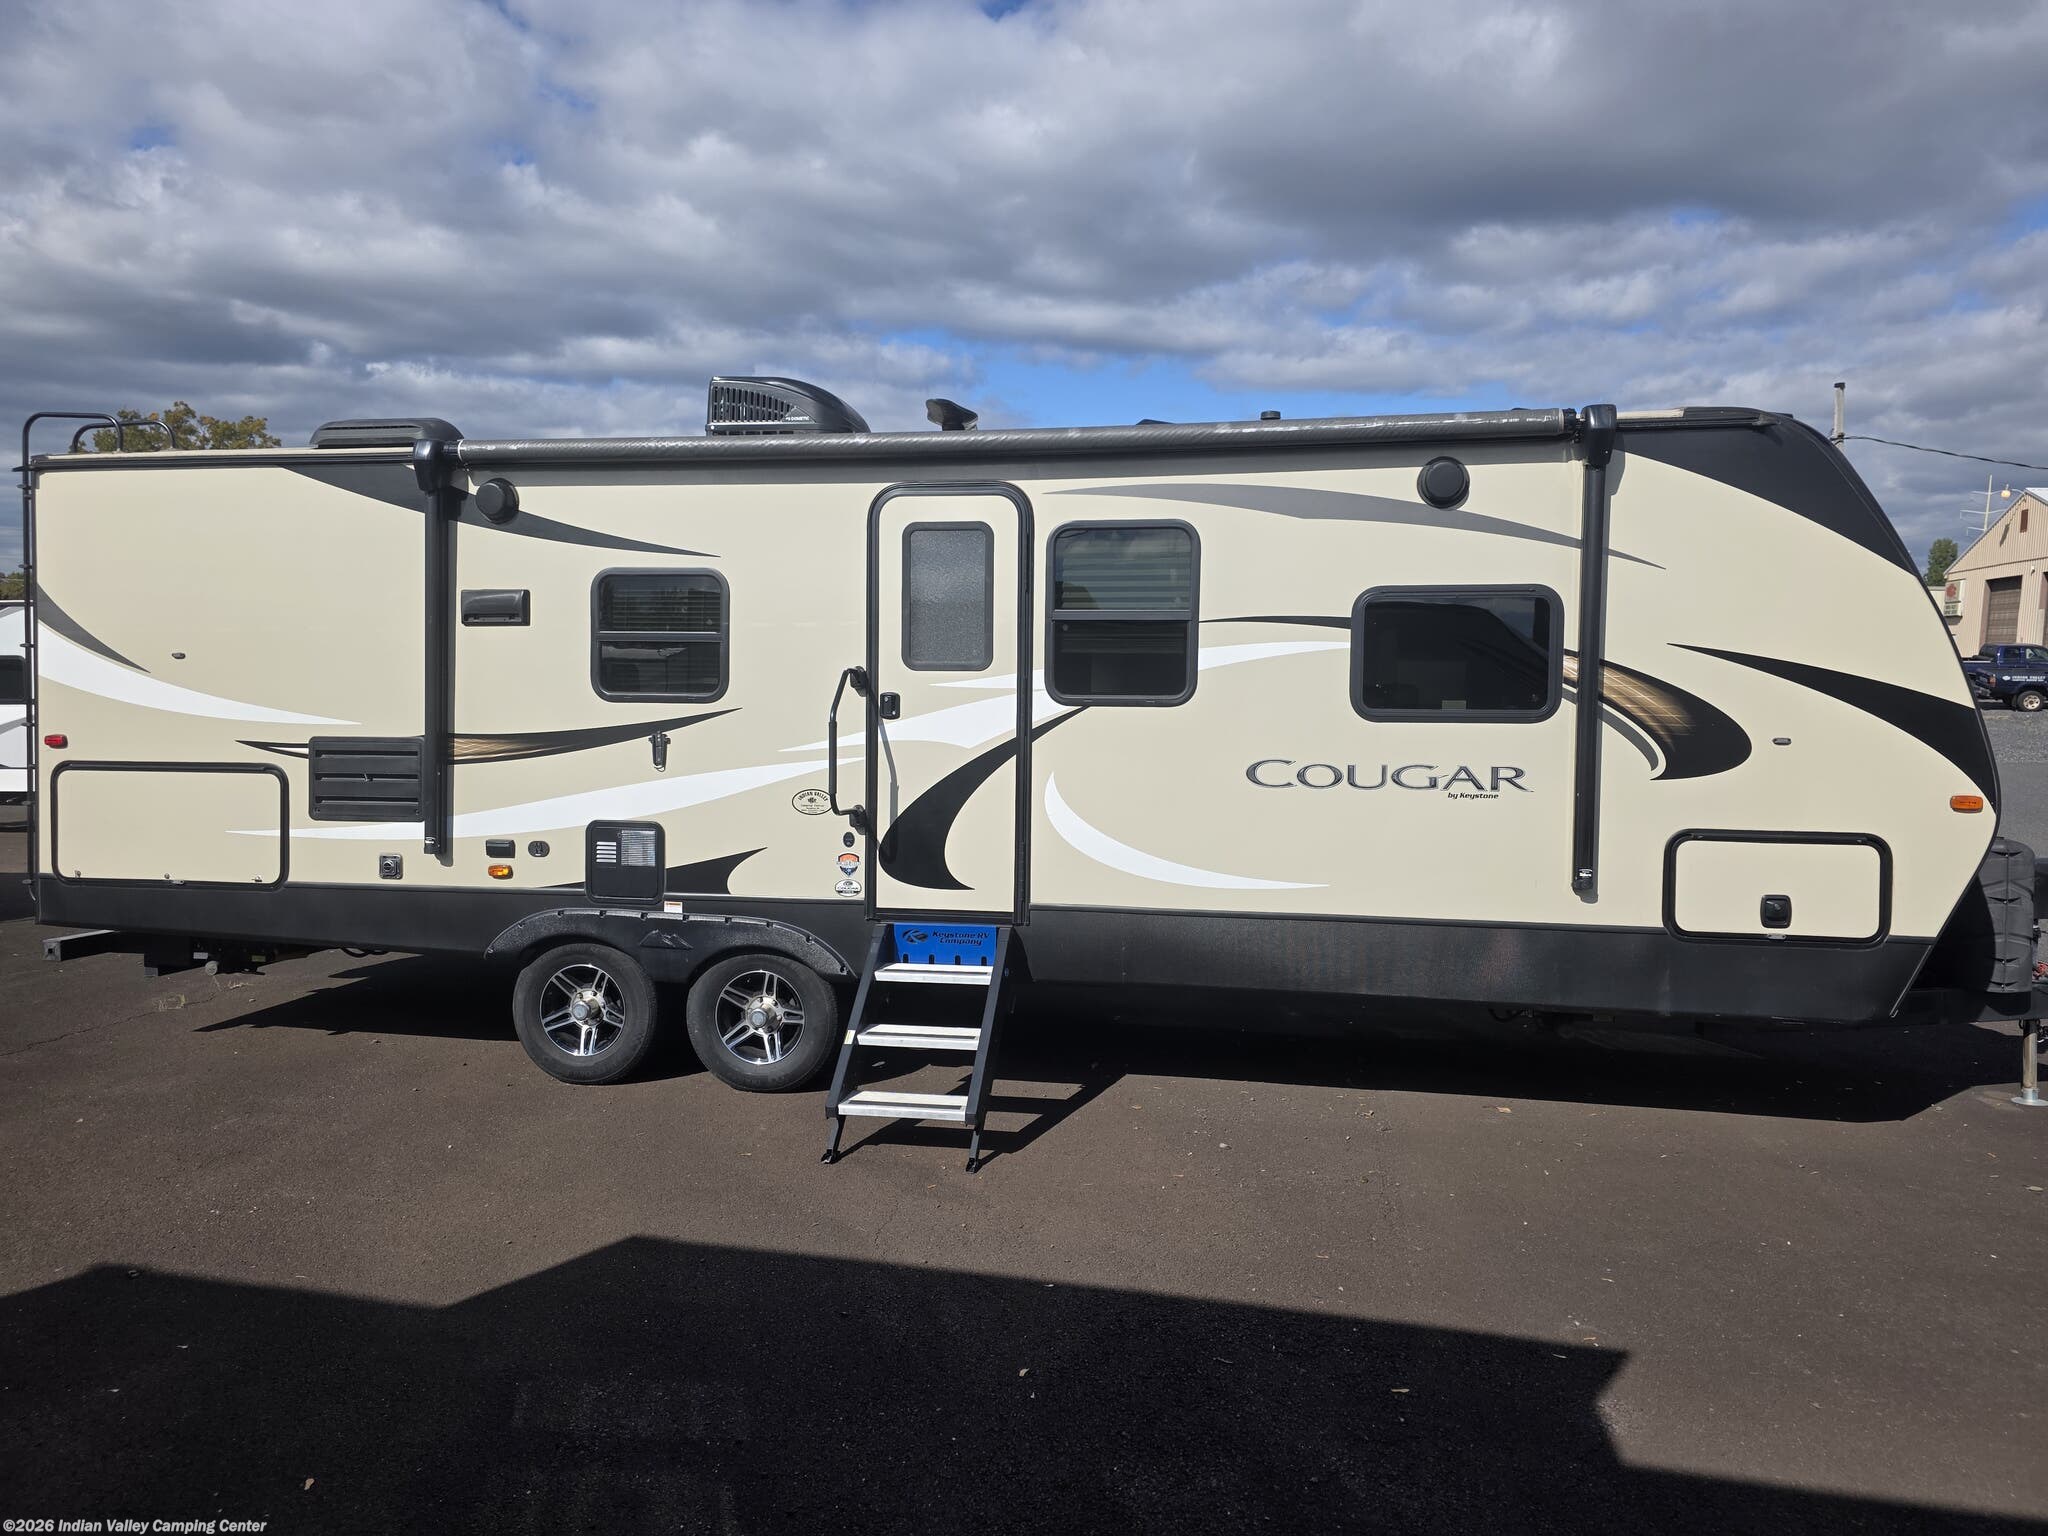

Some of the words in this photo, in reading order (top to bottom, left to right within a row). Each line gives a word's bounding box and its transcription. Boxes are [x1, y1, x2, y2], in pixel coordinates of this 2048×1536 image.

[1246, 759, 1534, 793] COUGAR
[1447, 792, 1459, 800] by
[1460, 792, 1499, 800] Keystone
[932, 930, 976, 939] Keystone
[977, 932, 989, 940] RV
[939, 937, 982, 946] Company
